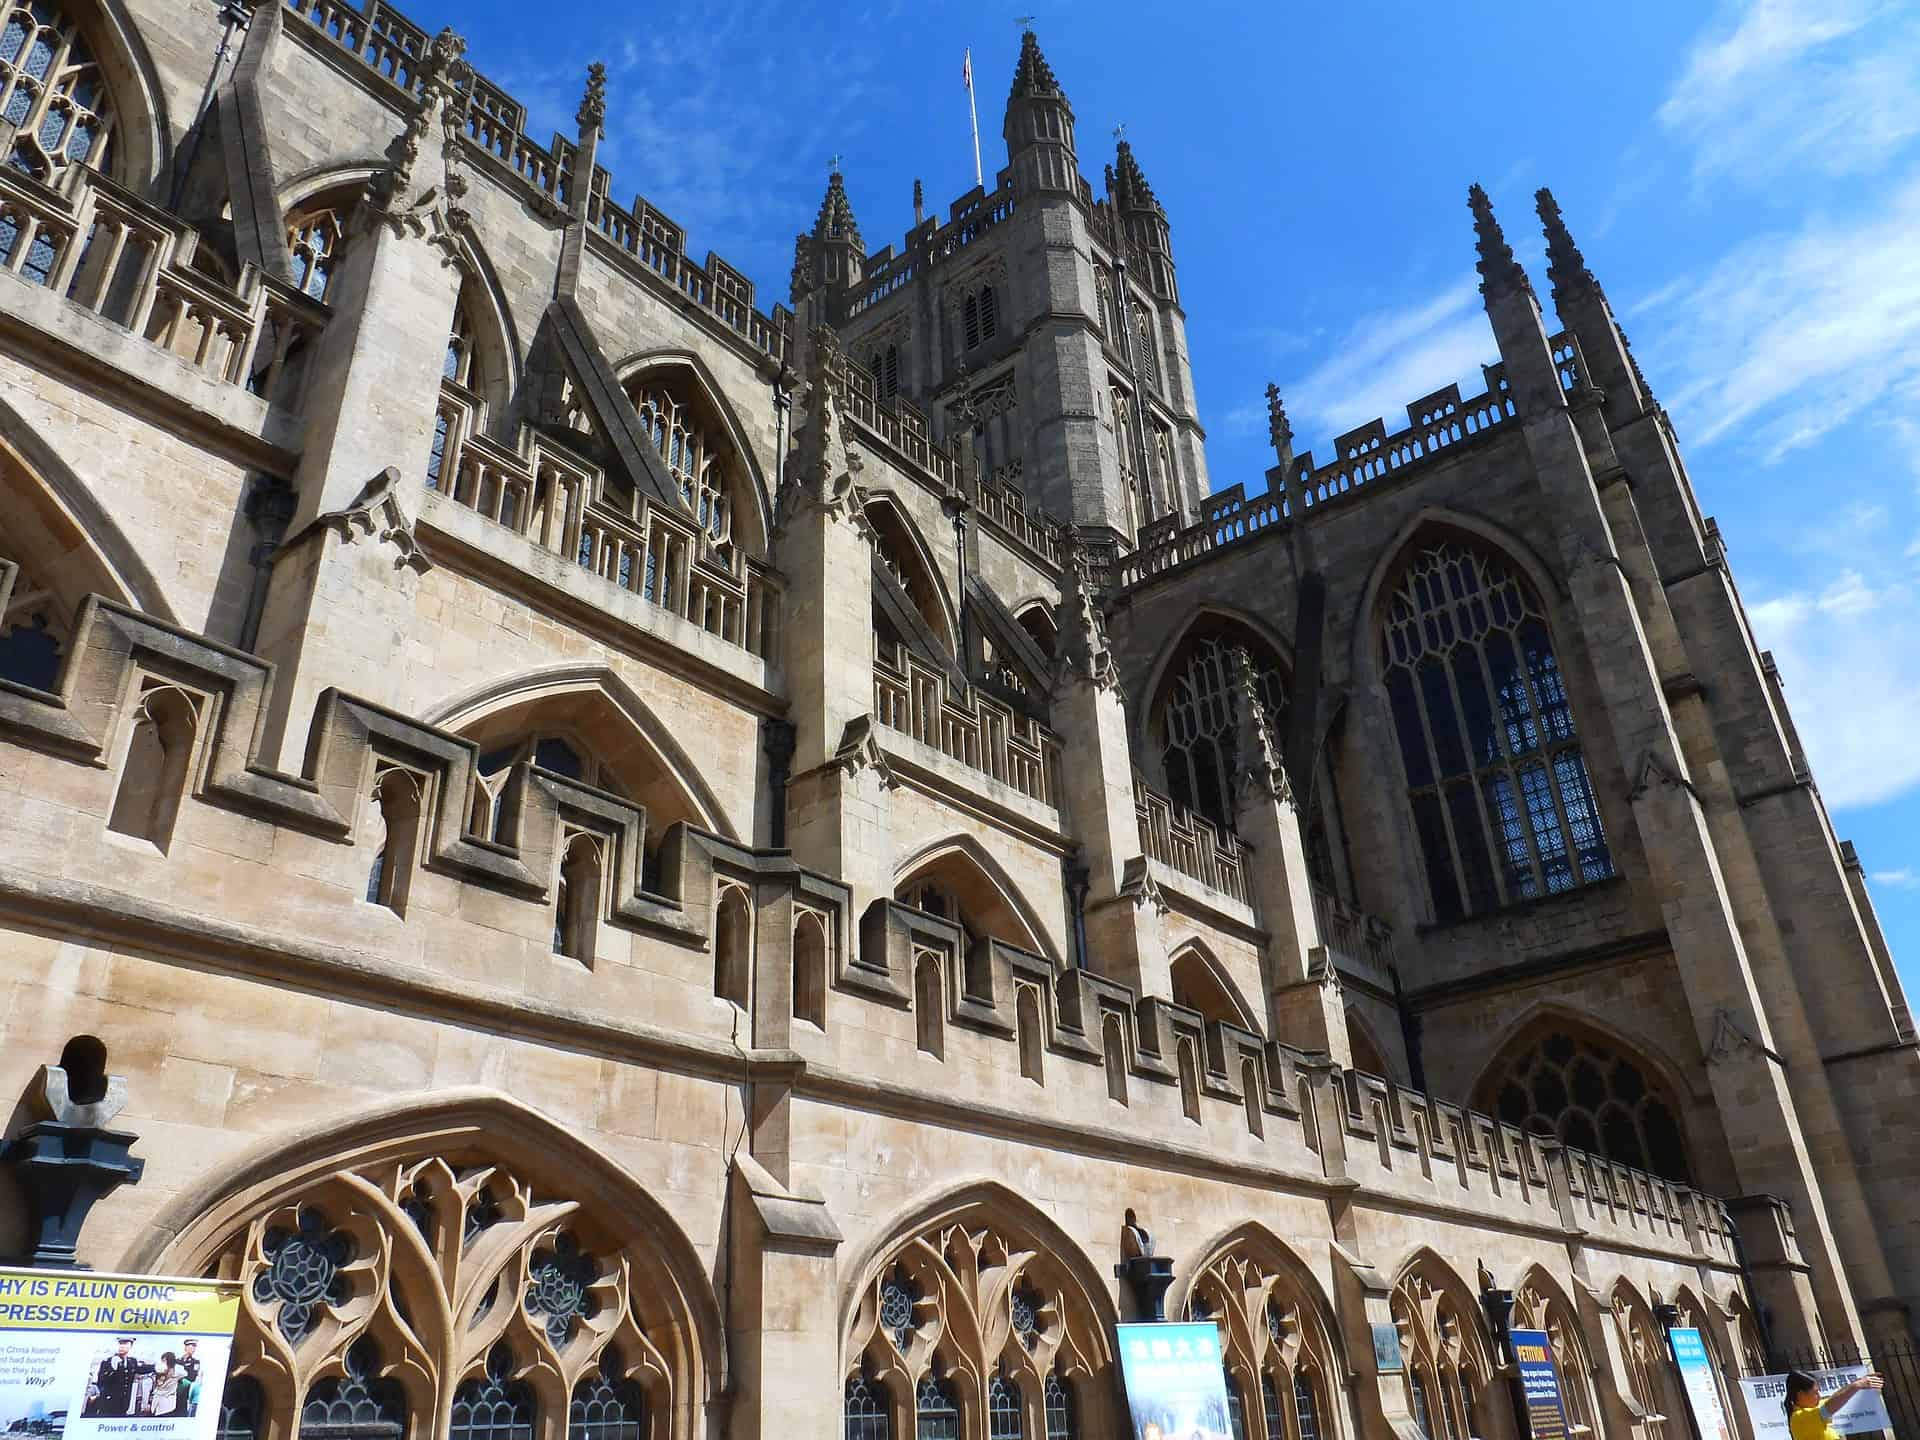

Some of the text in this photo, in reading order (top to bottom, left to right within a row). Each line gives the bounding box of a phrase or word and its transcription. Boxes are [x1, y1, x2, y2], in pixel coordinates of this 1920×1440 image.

[31, 1281, 49, 1296] IS
[55, 1282, 117, 1299] FALUN
[95, 1308, 116, 1324] IN
[120, 1308, 190, 1326] CHINA?
[25, 1376, 56, 1388] Why?
[97, 1423, 128, 1432] Power
[140, 1423, 176, 1432] control
